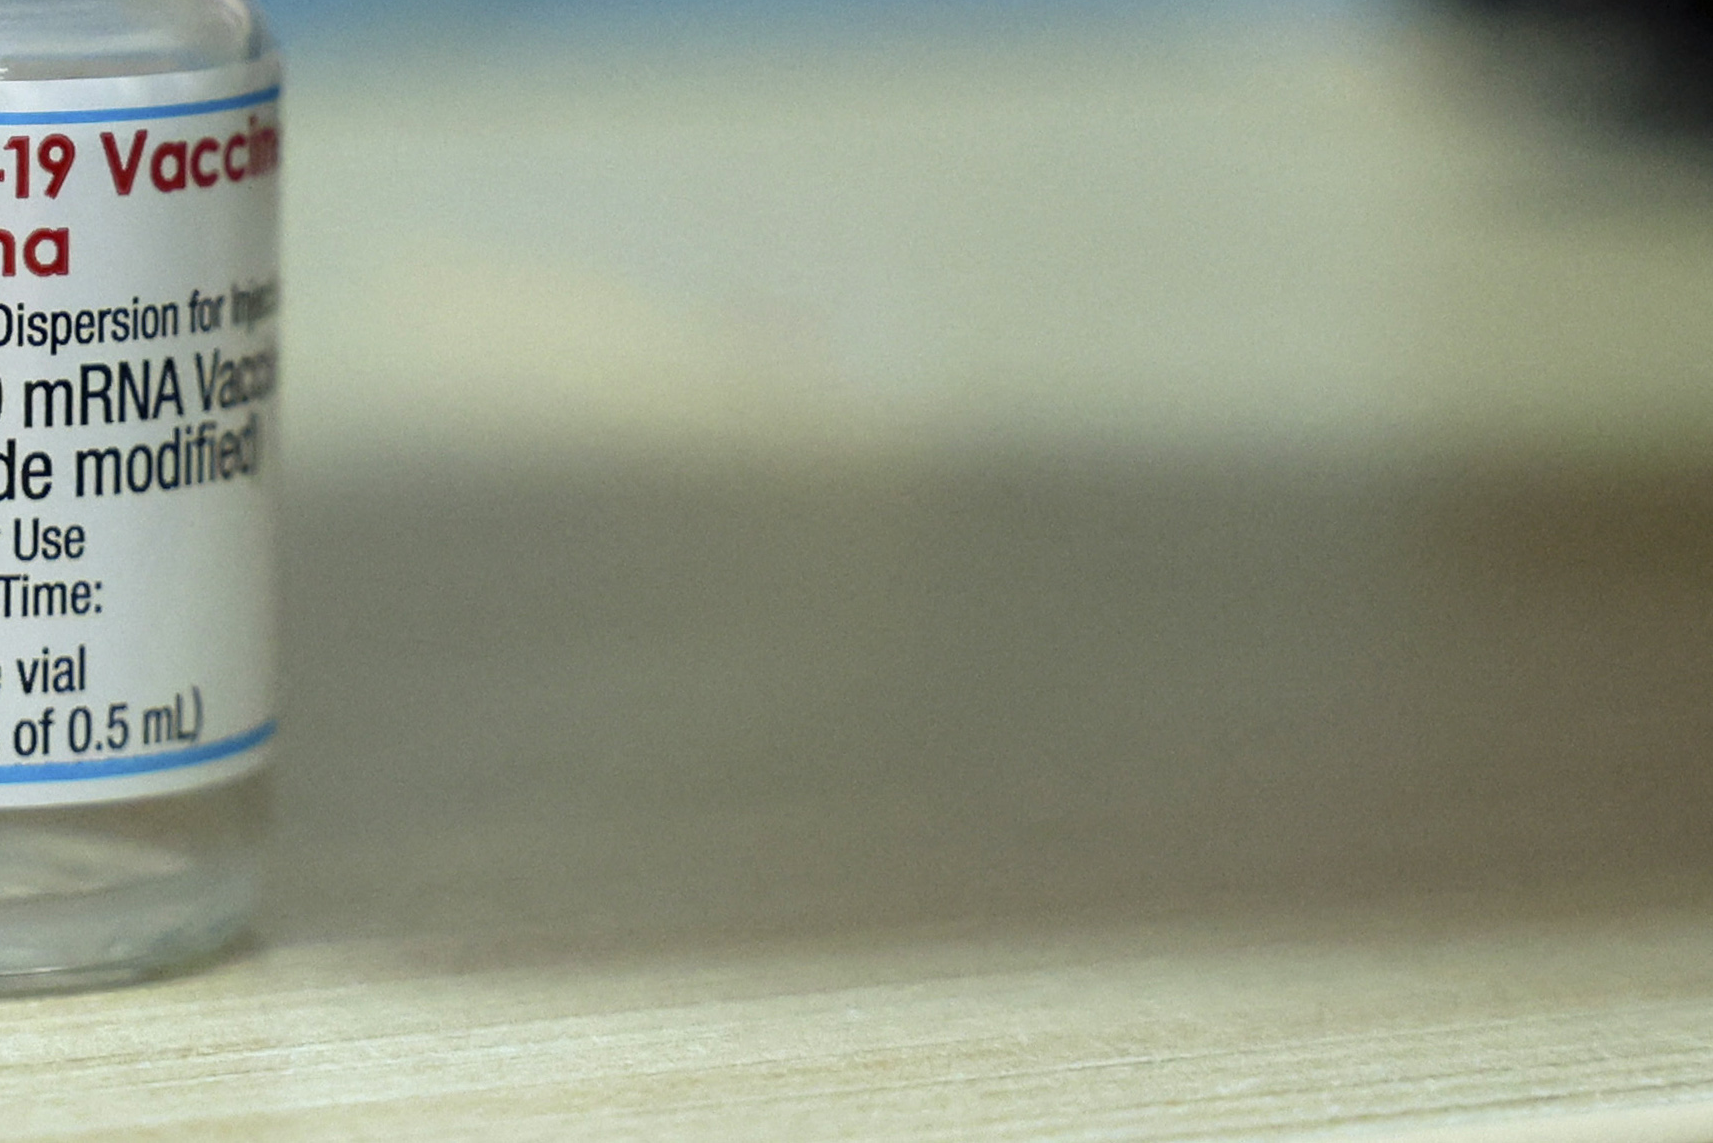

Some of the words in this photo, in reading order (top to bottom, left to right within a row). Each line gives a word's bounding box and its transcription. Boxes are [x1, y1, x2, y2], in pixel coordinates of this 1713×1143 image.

[188, 289, 224, 334] for
[23, 356, 184, 428] mRNA
[14, 518, 86, 561] Use
[16, 646, 86, 693] vial
[14, 713, 54, 758] of
[68, 705, 130, 753] 0.5
[143, 686, 204, 745] mL)
